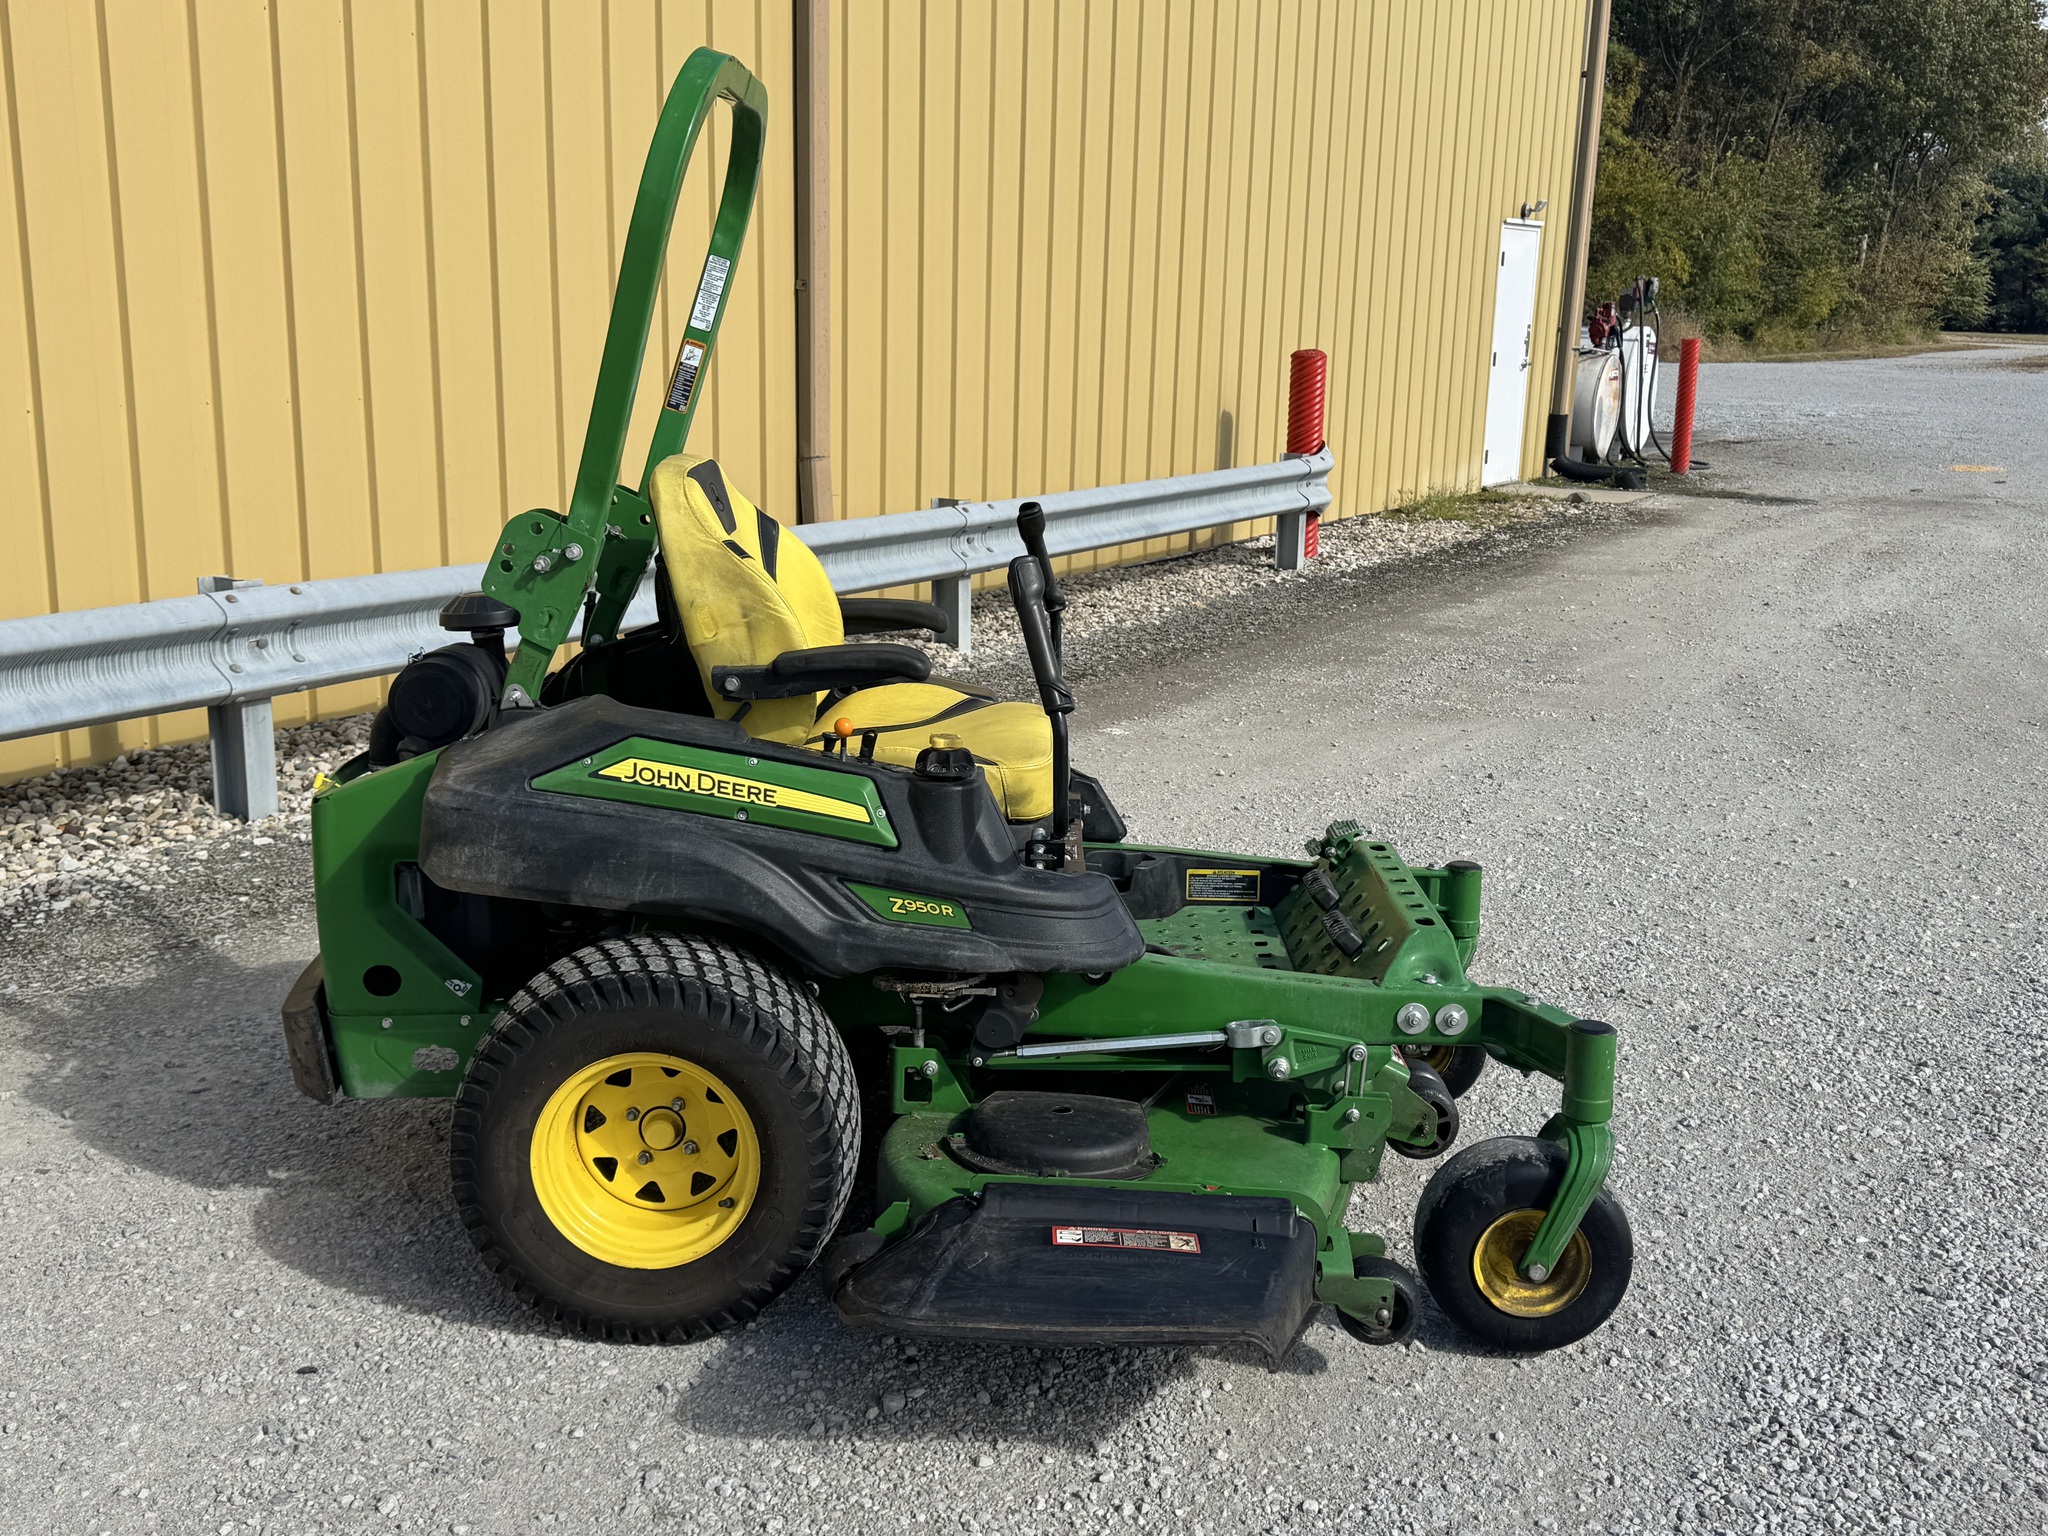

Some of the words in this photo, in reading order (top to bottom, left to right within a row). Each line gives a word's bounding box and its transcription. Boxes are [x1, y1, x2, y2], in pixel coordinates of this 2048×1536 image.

[624, 762, 691, 789] JOHN
[697, 772, 777, 804] DEERE
[889, 897, 955, 917] Z950R
